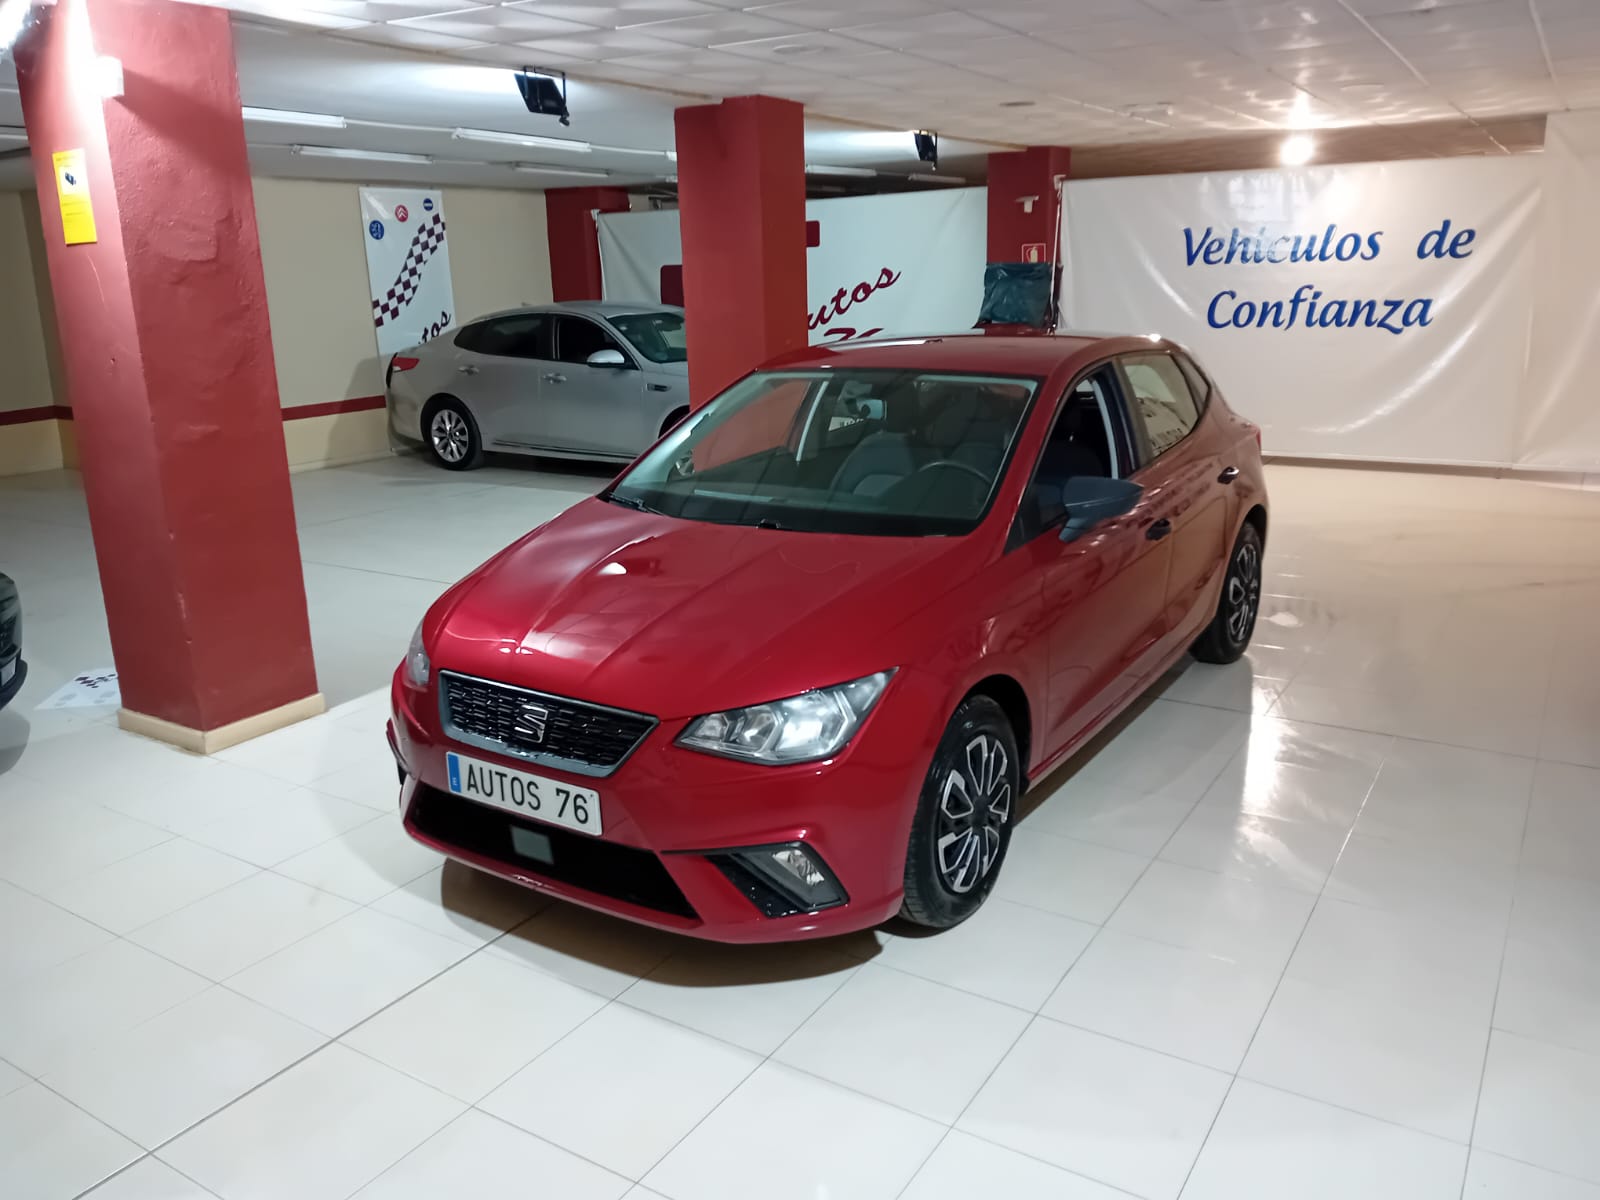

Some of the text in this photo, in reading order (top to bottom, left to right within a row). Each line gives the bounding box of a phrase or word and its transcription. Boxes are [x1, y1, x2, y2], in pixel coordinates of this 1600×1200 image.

[1417, 219, 1476, 260] de
[807, 267, 902, 330] utos
[1207, 284, 1434, 335] Confianza
[418, 310, 452, 344] tos
[467, 763, 589, 824] AUTOS 76
